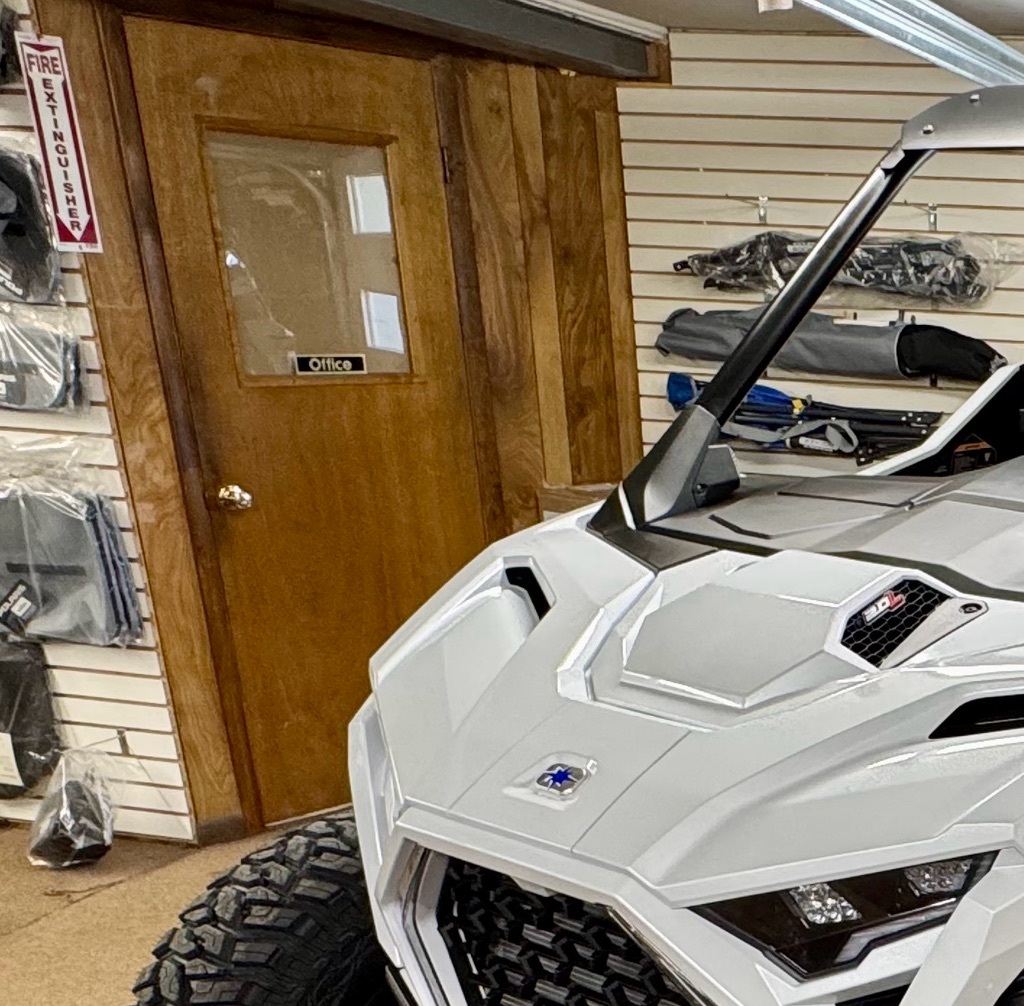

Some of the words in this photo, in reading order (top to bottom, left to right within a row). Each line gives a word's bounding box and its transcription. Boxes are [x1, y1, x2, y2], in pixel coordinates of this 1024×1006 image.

[26, 53, 61, 75] FIRE
[42, 78, 82, 231] EXTINGUISHER
[308, 357, 353, 371] Office
